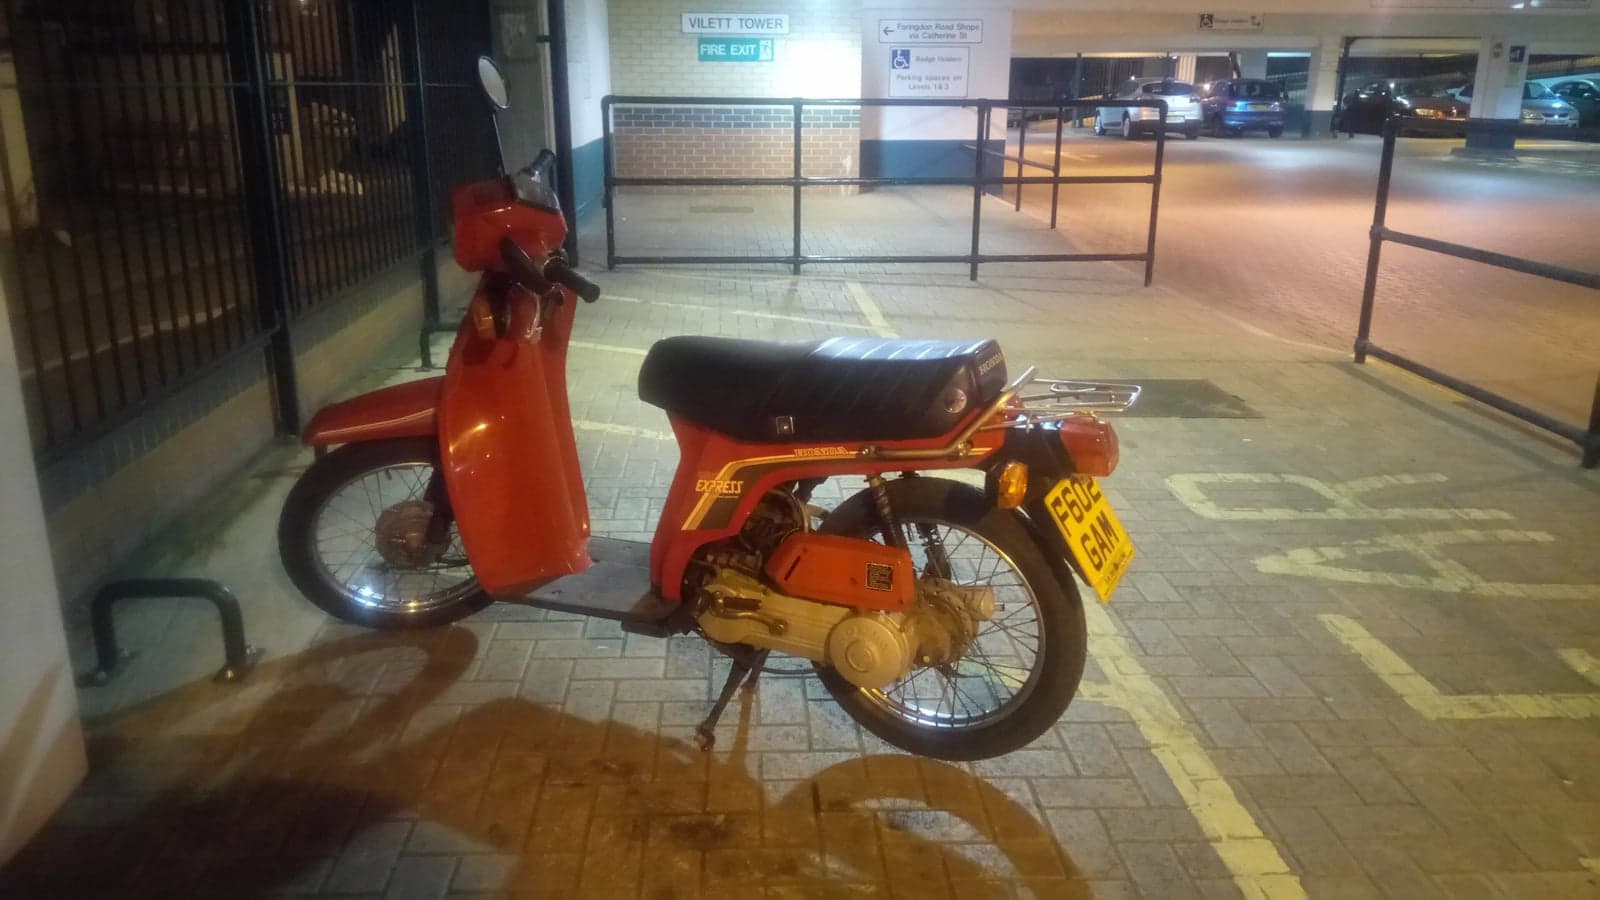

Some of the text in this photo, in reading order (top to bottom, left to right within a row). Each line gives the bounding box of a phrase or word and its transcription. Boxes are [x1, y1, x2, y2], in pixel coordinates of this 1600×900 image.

[688, 17, 783, 30] VILETT TOWER
[935, 23, 954, 31] Road
[921, 32, 957, 40] Catherine
[959, 32, 968, 40] St
[700, 43, 757, 56] FIRE EXIT
[896, 74, 922, 83] Parking
[794, 446, 848, 457] HONDA
[695, 479, 744, 494] EXPRESS
[1080, 510, 1120, 572] GAM
